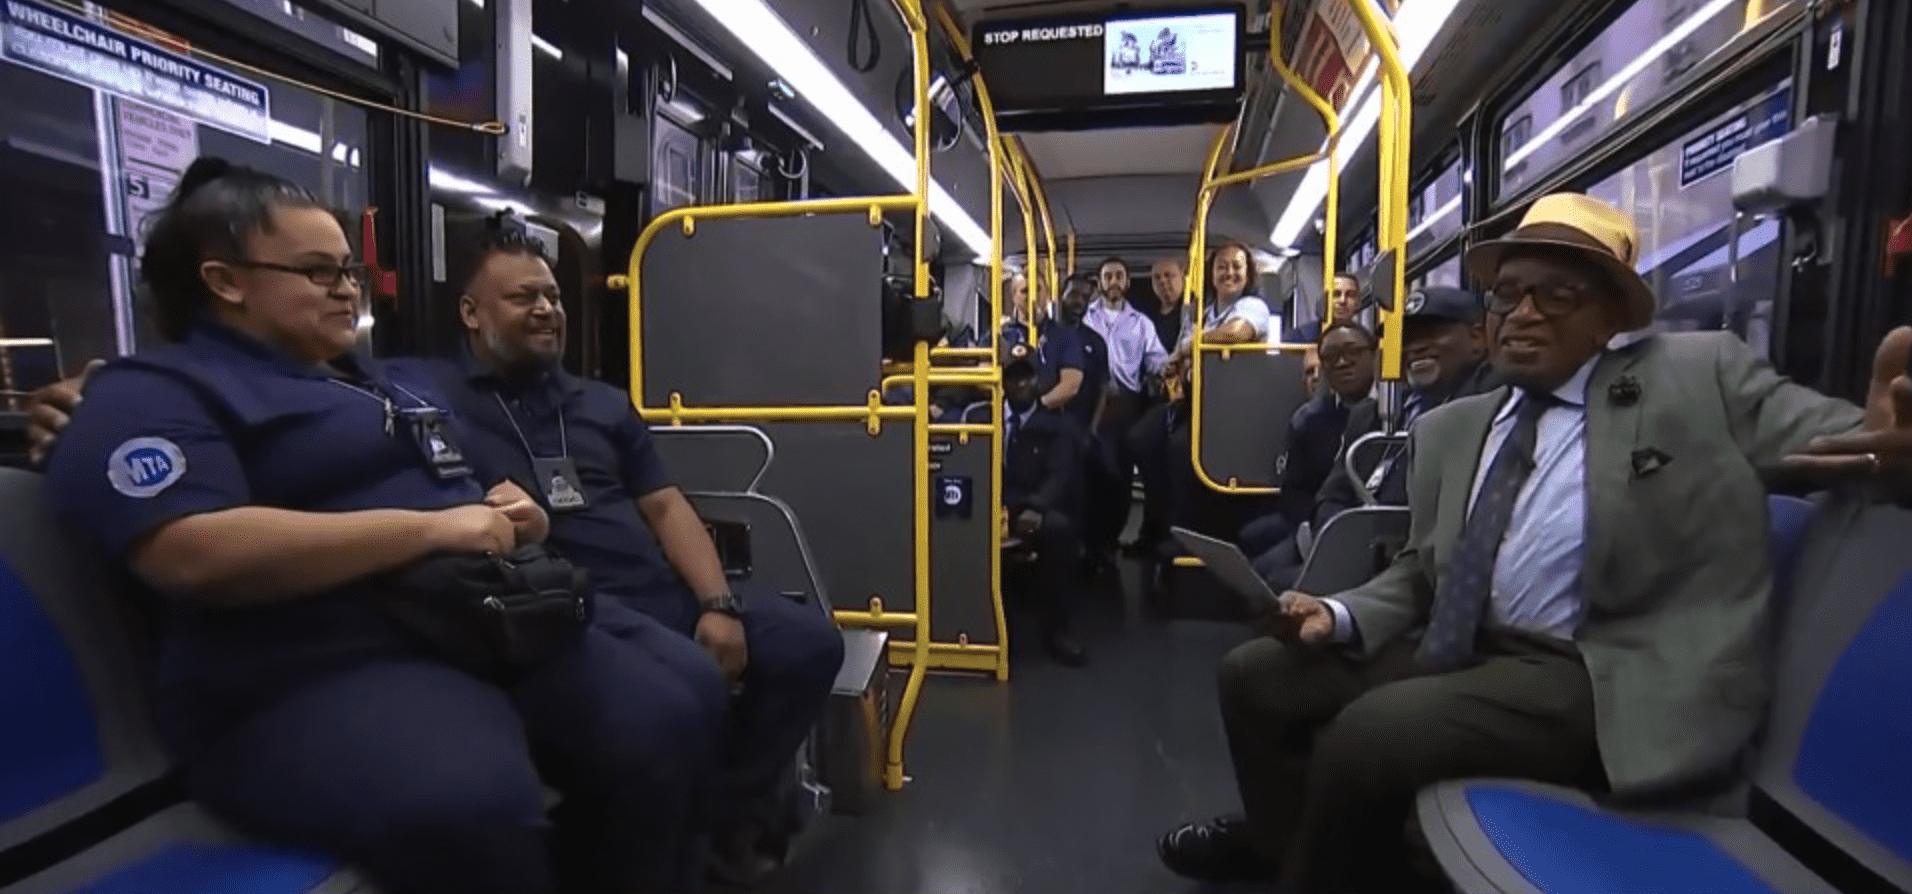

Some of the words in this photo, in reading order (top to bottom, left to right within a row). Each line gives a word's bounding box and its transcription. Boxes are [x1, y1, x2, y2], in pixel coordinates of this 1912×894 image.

[984, 31, 1019, 45] STOP
[1022, 24, 1103, 41] REQUESTED
[7, 0, 127, 58] WHEELCHAIR
[130, 45, 200, 83] PRIORITY
[204, 73, 260, 107] SEATING
[126, 455, 170, 484] MTA
